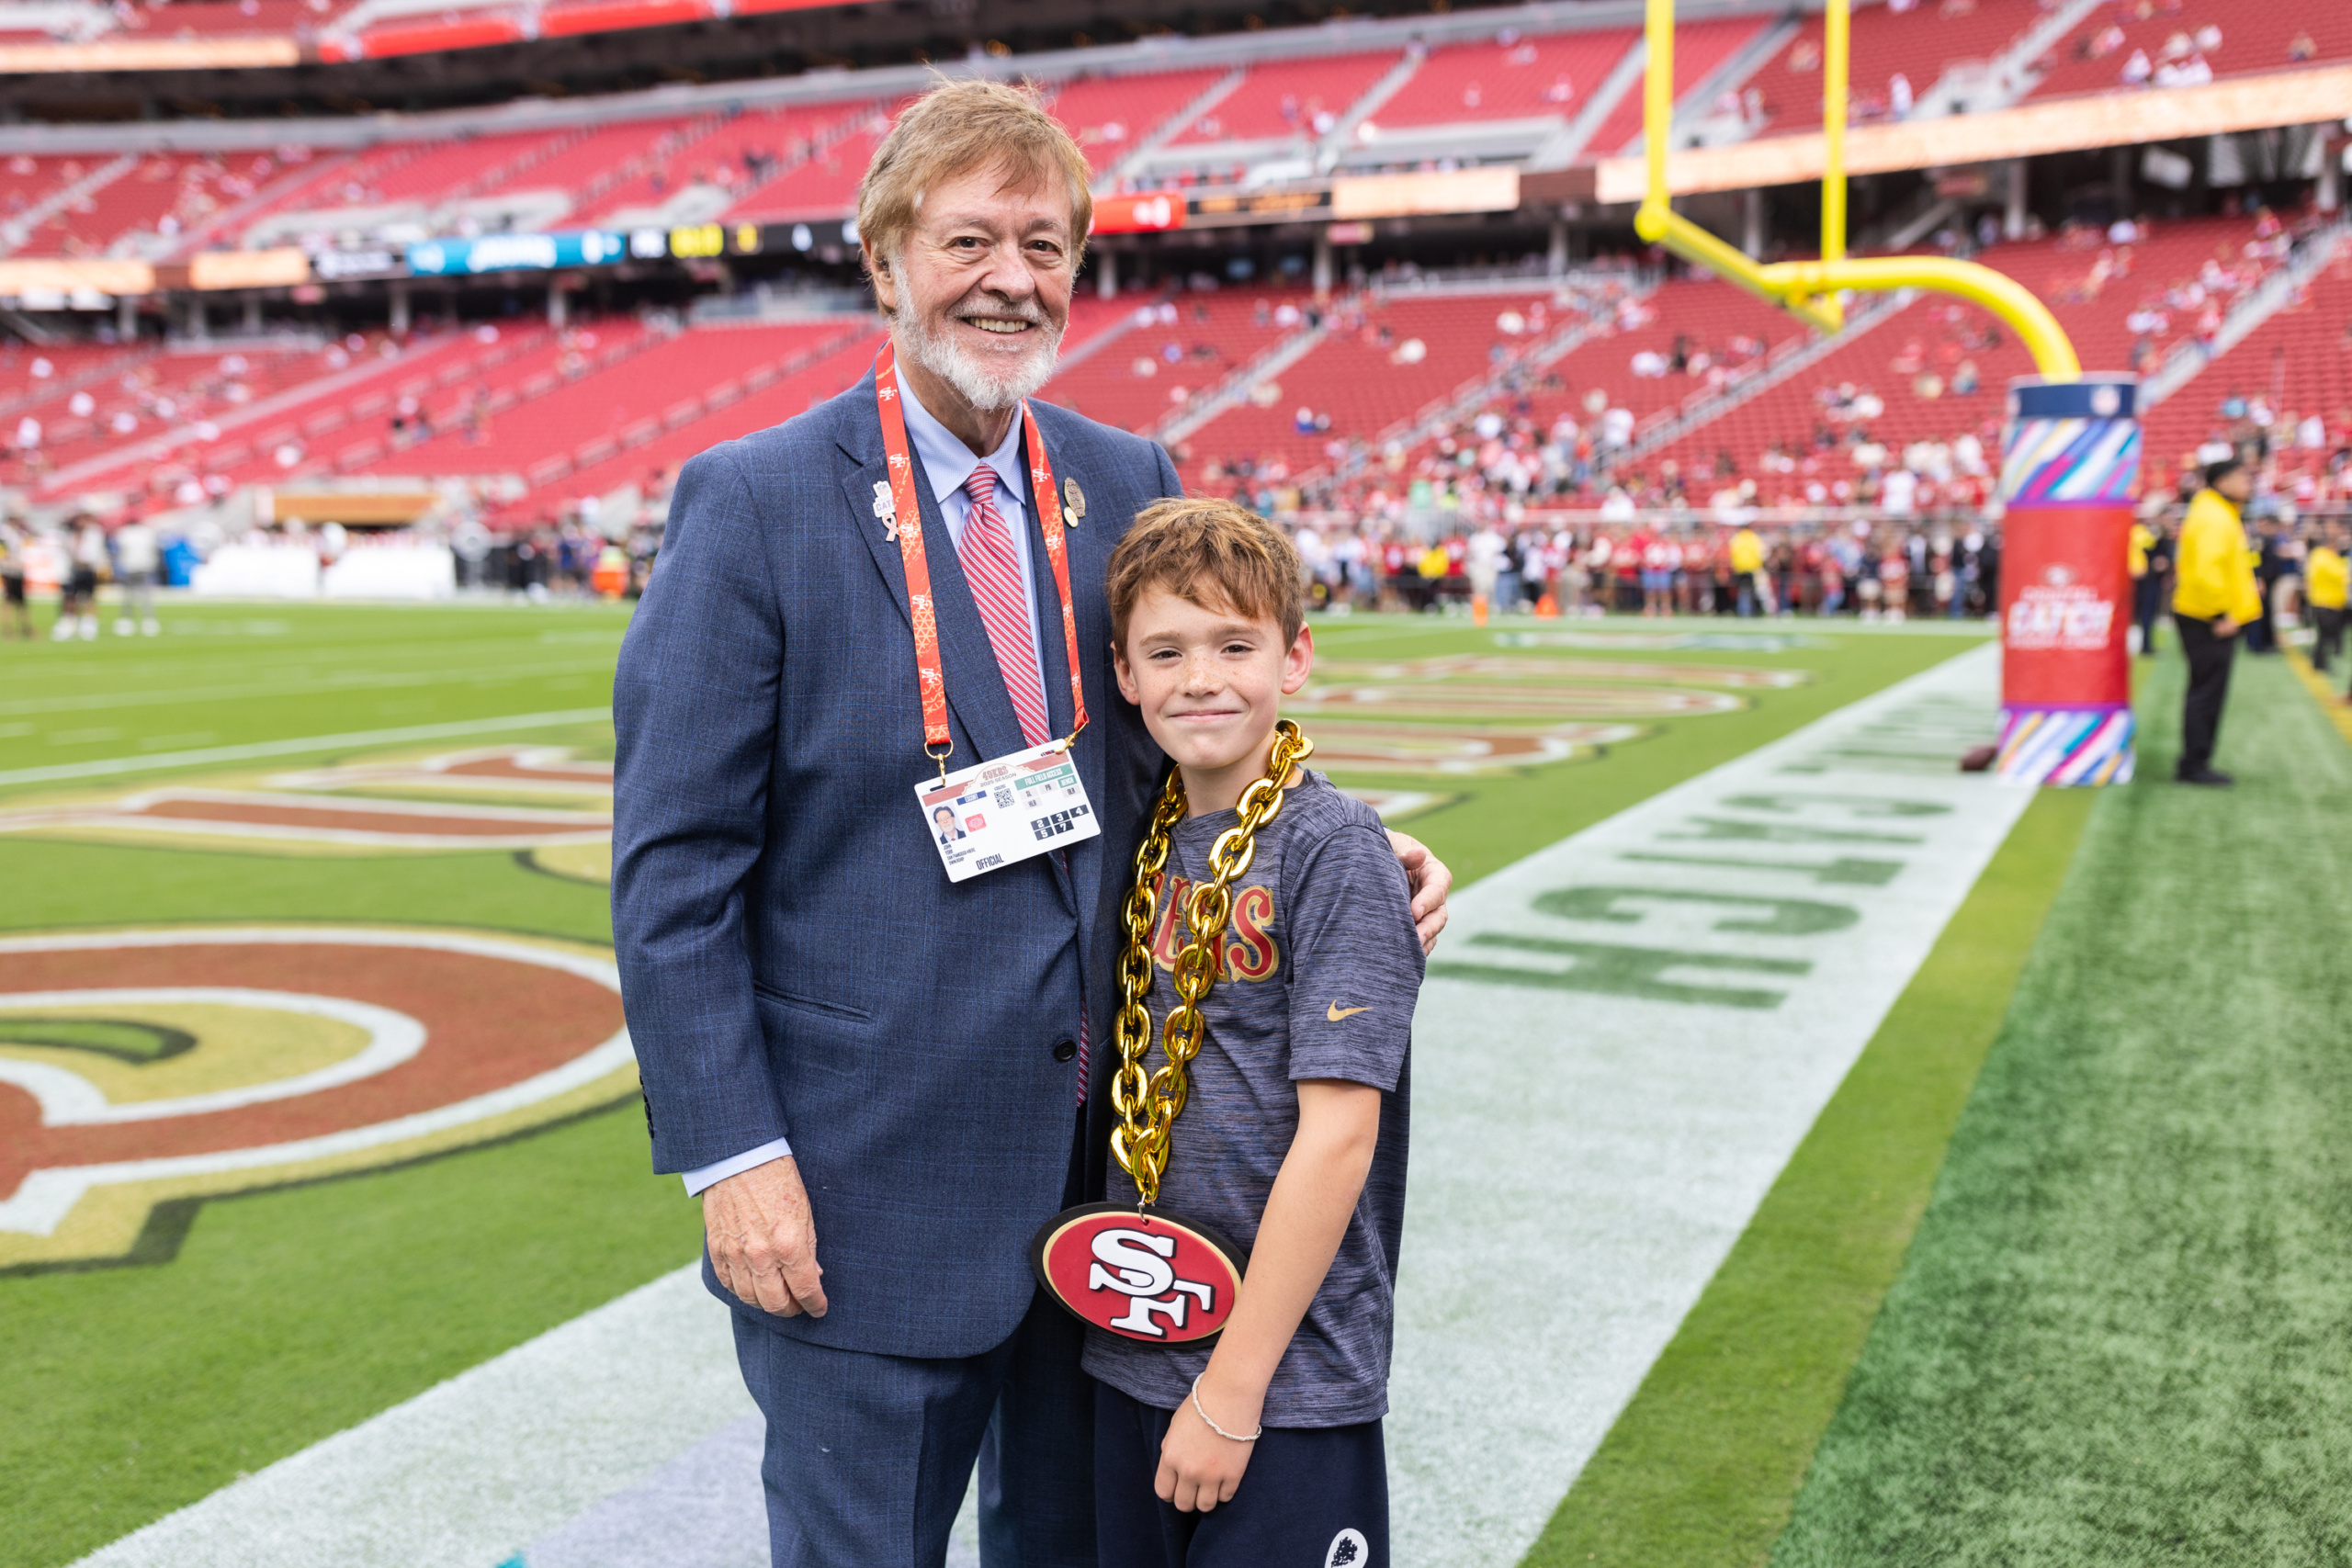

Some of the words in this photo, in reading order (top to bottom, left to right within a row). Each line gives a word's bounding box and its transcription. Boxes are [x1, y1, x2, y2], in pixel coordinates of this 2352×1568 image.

[982, 765, 1009, 781] 49ERS
[995, 773, 1016, 783] SEASON
[1024, 776, 1035, 785] FULL
[1035, 773, 1046, 782] FIELD
[1046, 768, 1063, 778] ACCESS
[1036, 819, 1045, 828] 2
[1056, 813, 1064, 821] 3
[1076, 807, 1083, 815] 4
[1040, 829, 1048, 838] 5
[1059, 823, 1067, 831] 7
[976, 853, 1004, 870] OFFICIAL
[1089, 1227, 1215, 1337] SF
